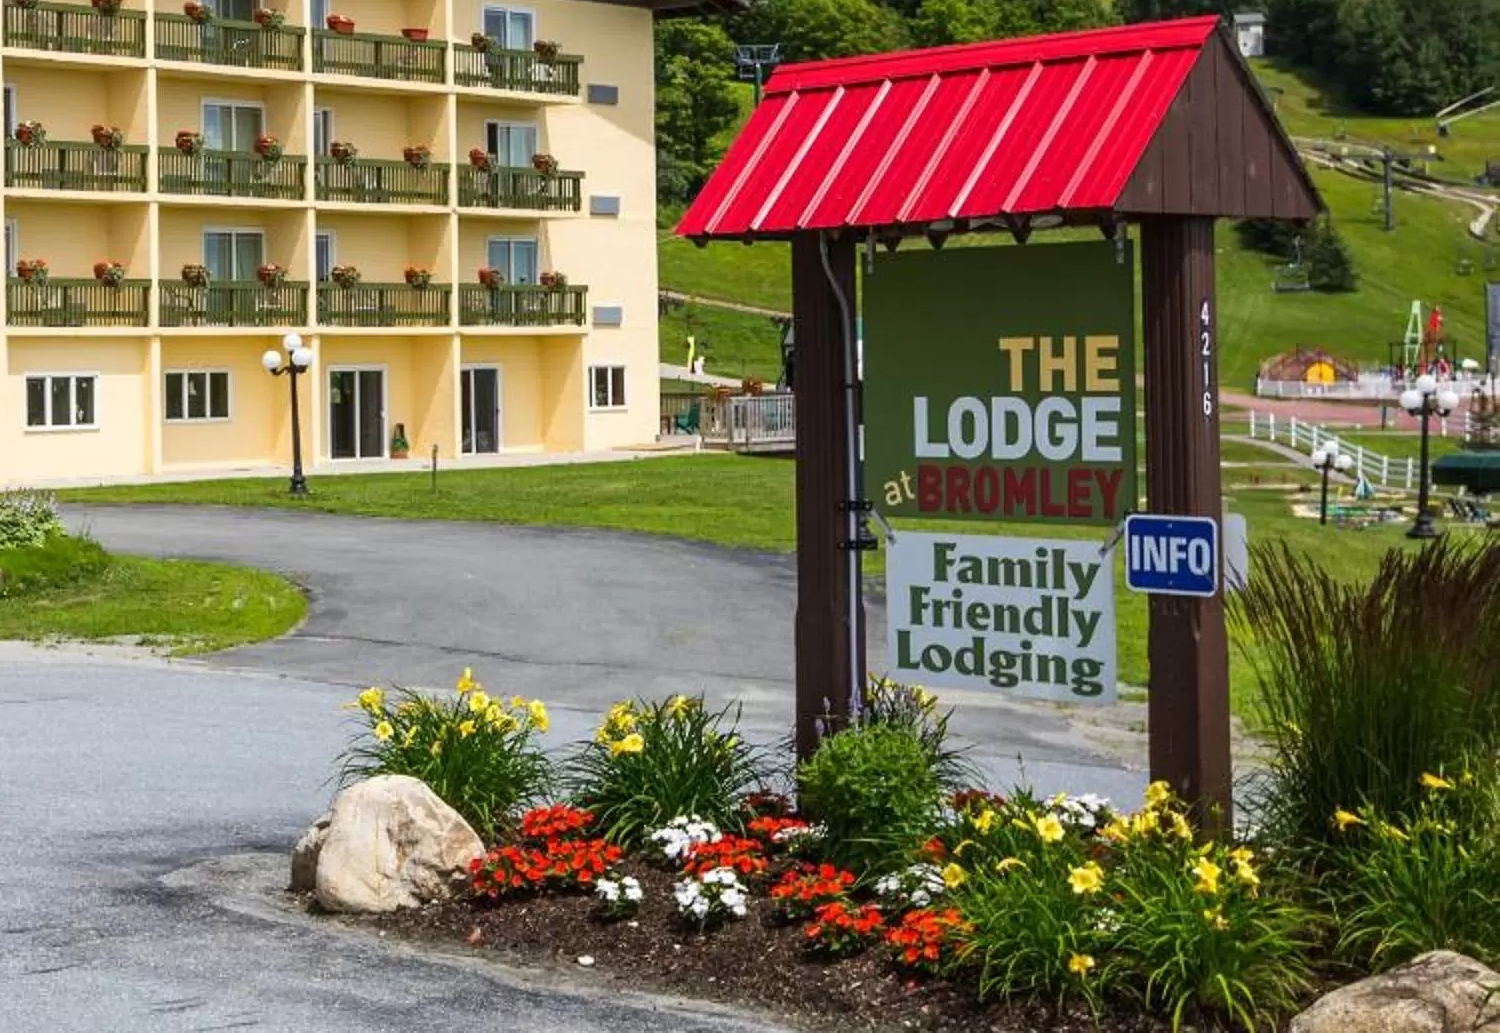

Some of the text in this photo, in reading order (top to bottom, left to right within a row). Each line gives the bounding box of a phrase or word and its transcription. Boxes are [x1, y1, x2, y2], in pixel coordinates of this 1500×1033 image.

[998, 335, 1121, 392] THE
[1201, 301, 1213, 416] 4216
[913, 396, 1123, 462] LODGE
[883, 465, 1123, 519] at BROMLEY
[933, 542, 1100, 600] Family
[1130, 534, 1212, 577] INFO
[909, 586, 1101, 648] Friendly
[896, 630, 1105, 697] Lodging
